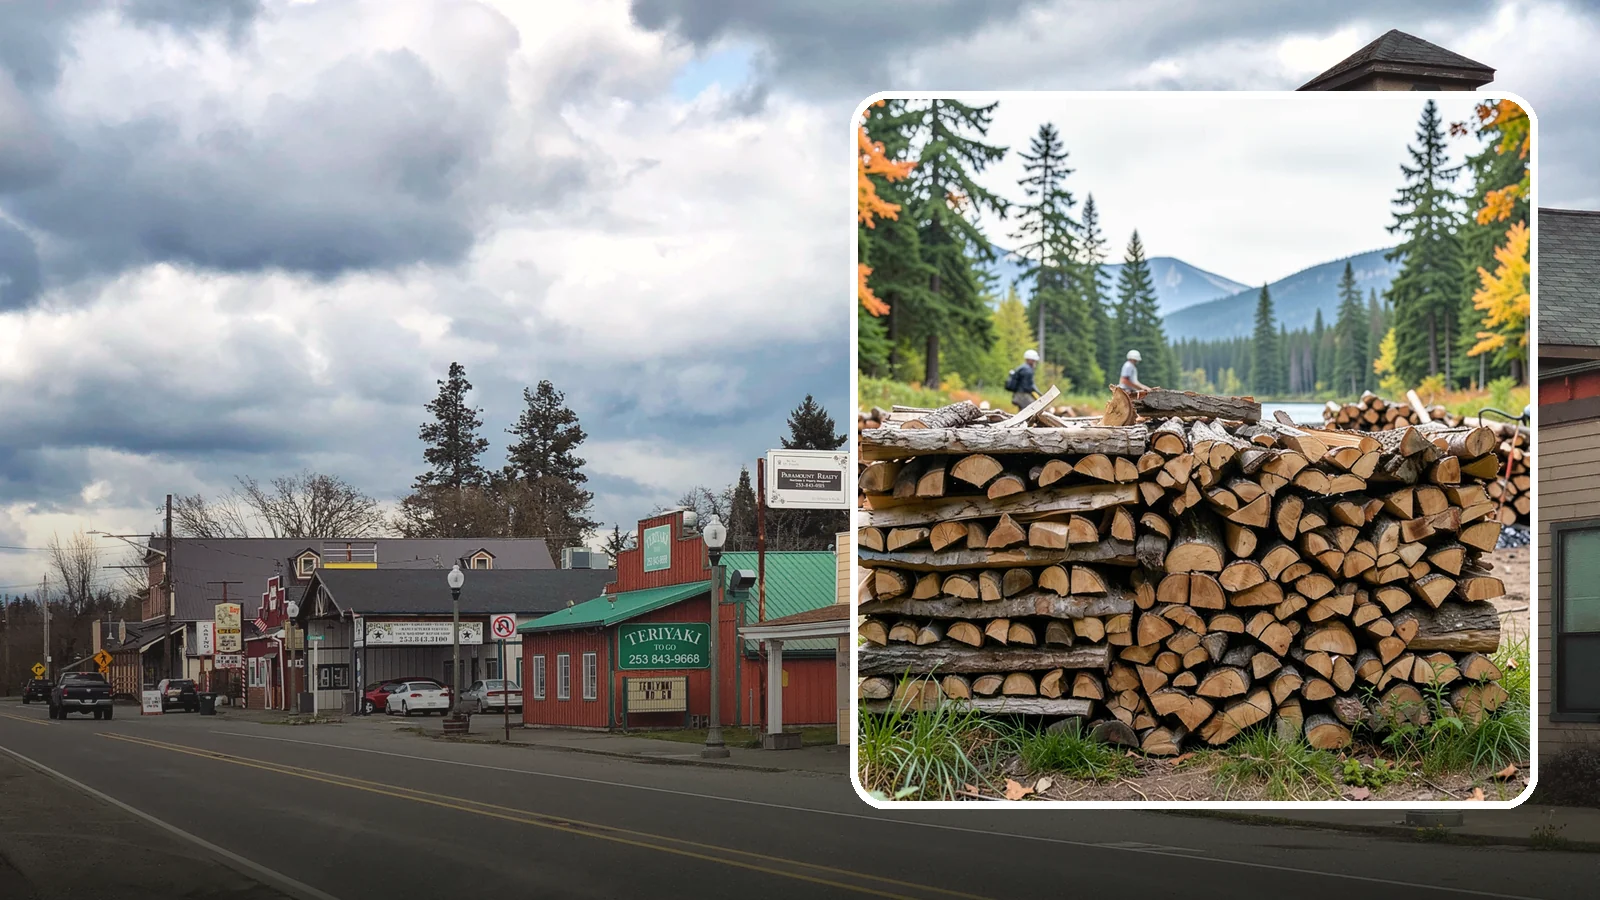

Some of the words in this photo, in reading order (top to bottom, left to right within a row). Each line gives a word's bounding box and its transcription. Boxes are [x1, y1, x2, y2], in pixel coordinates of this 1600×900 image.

[817, 472, 838, 480] REALTY
[625, 627, 702, 646] TERIYAKI
[629, 654, 648, 665] 253
[651, 653, 700, 664] 843-9668
[639, 681, 673, 691] TERIYAKI
